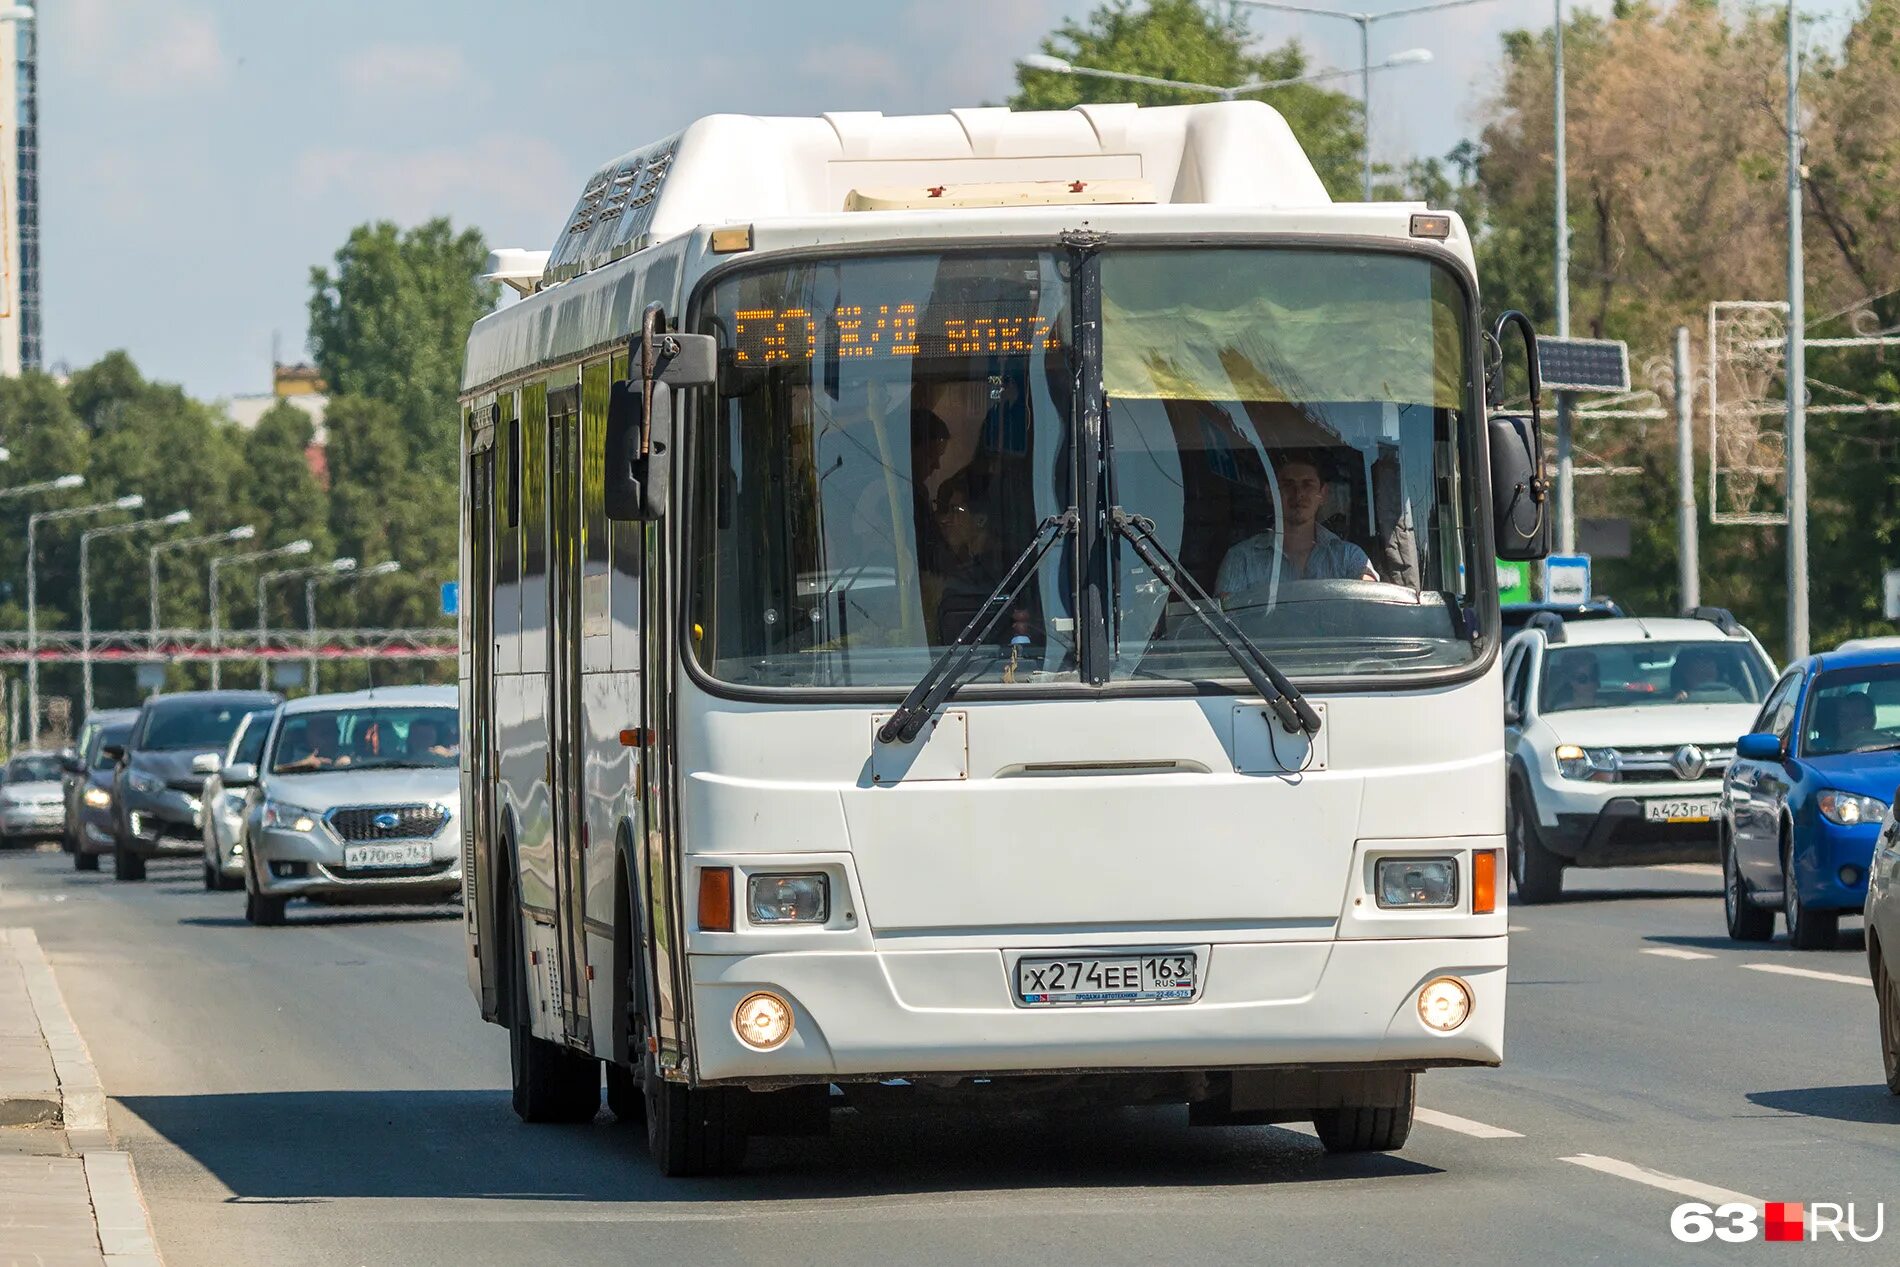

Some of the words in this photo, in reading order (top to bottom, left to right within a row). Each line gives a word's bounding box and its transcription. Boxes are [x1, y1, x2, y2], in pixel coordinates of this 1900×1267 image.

[1030, 961, 1139, 991] Х274ЕЕ
[1146, 958, 1186, 979] 163
[1155, 979, 1176, 988] RUS
[1075, 992, 1101, 1000] ПРОДАЖА
